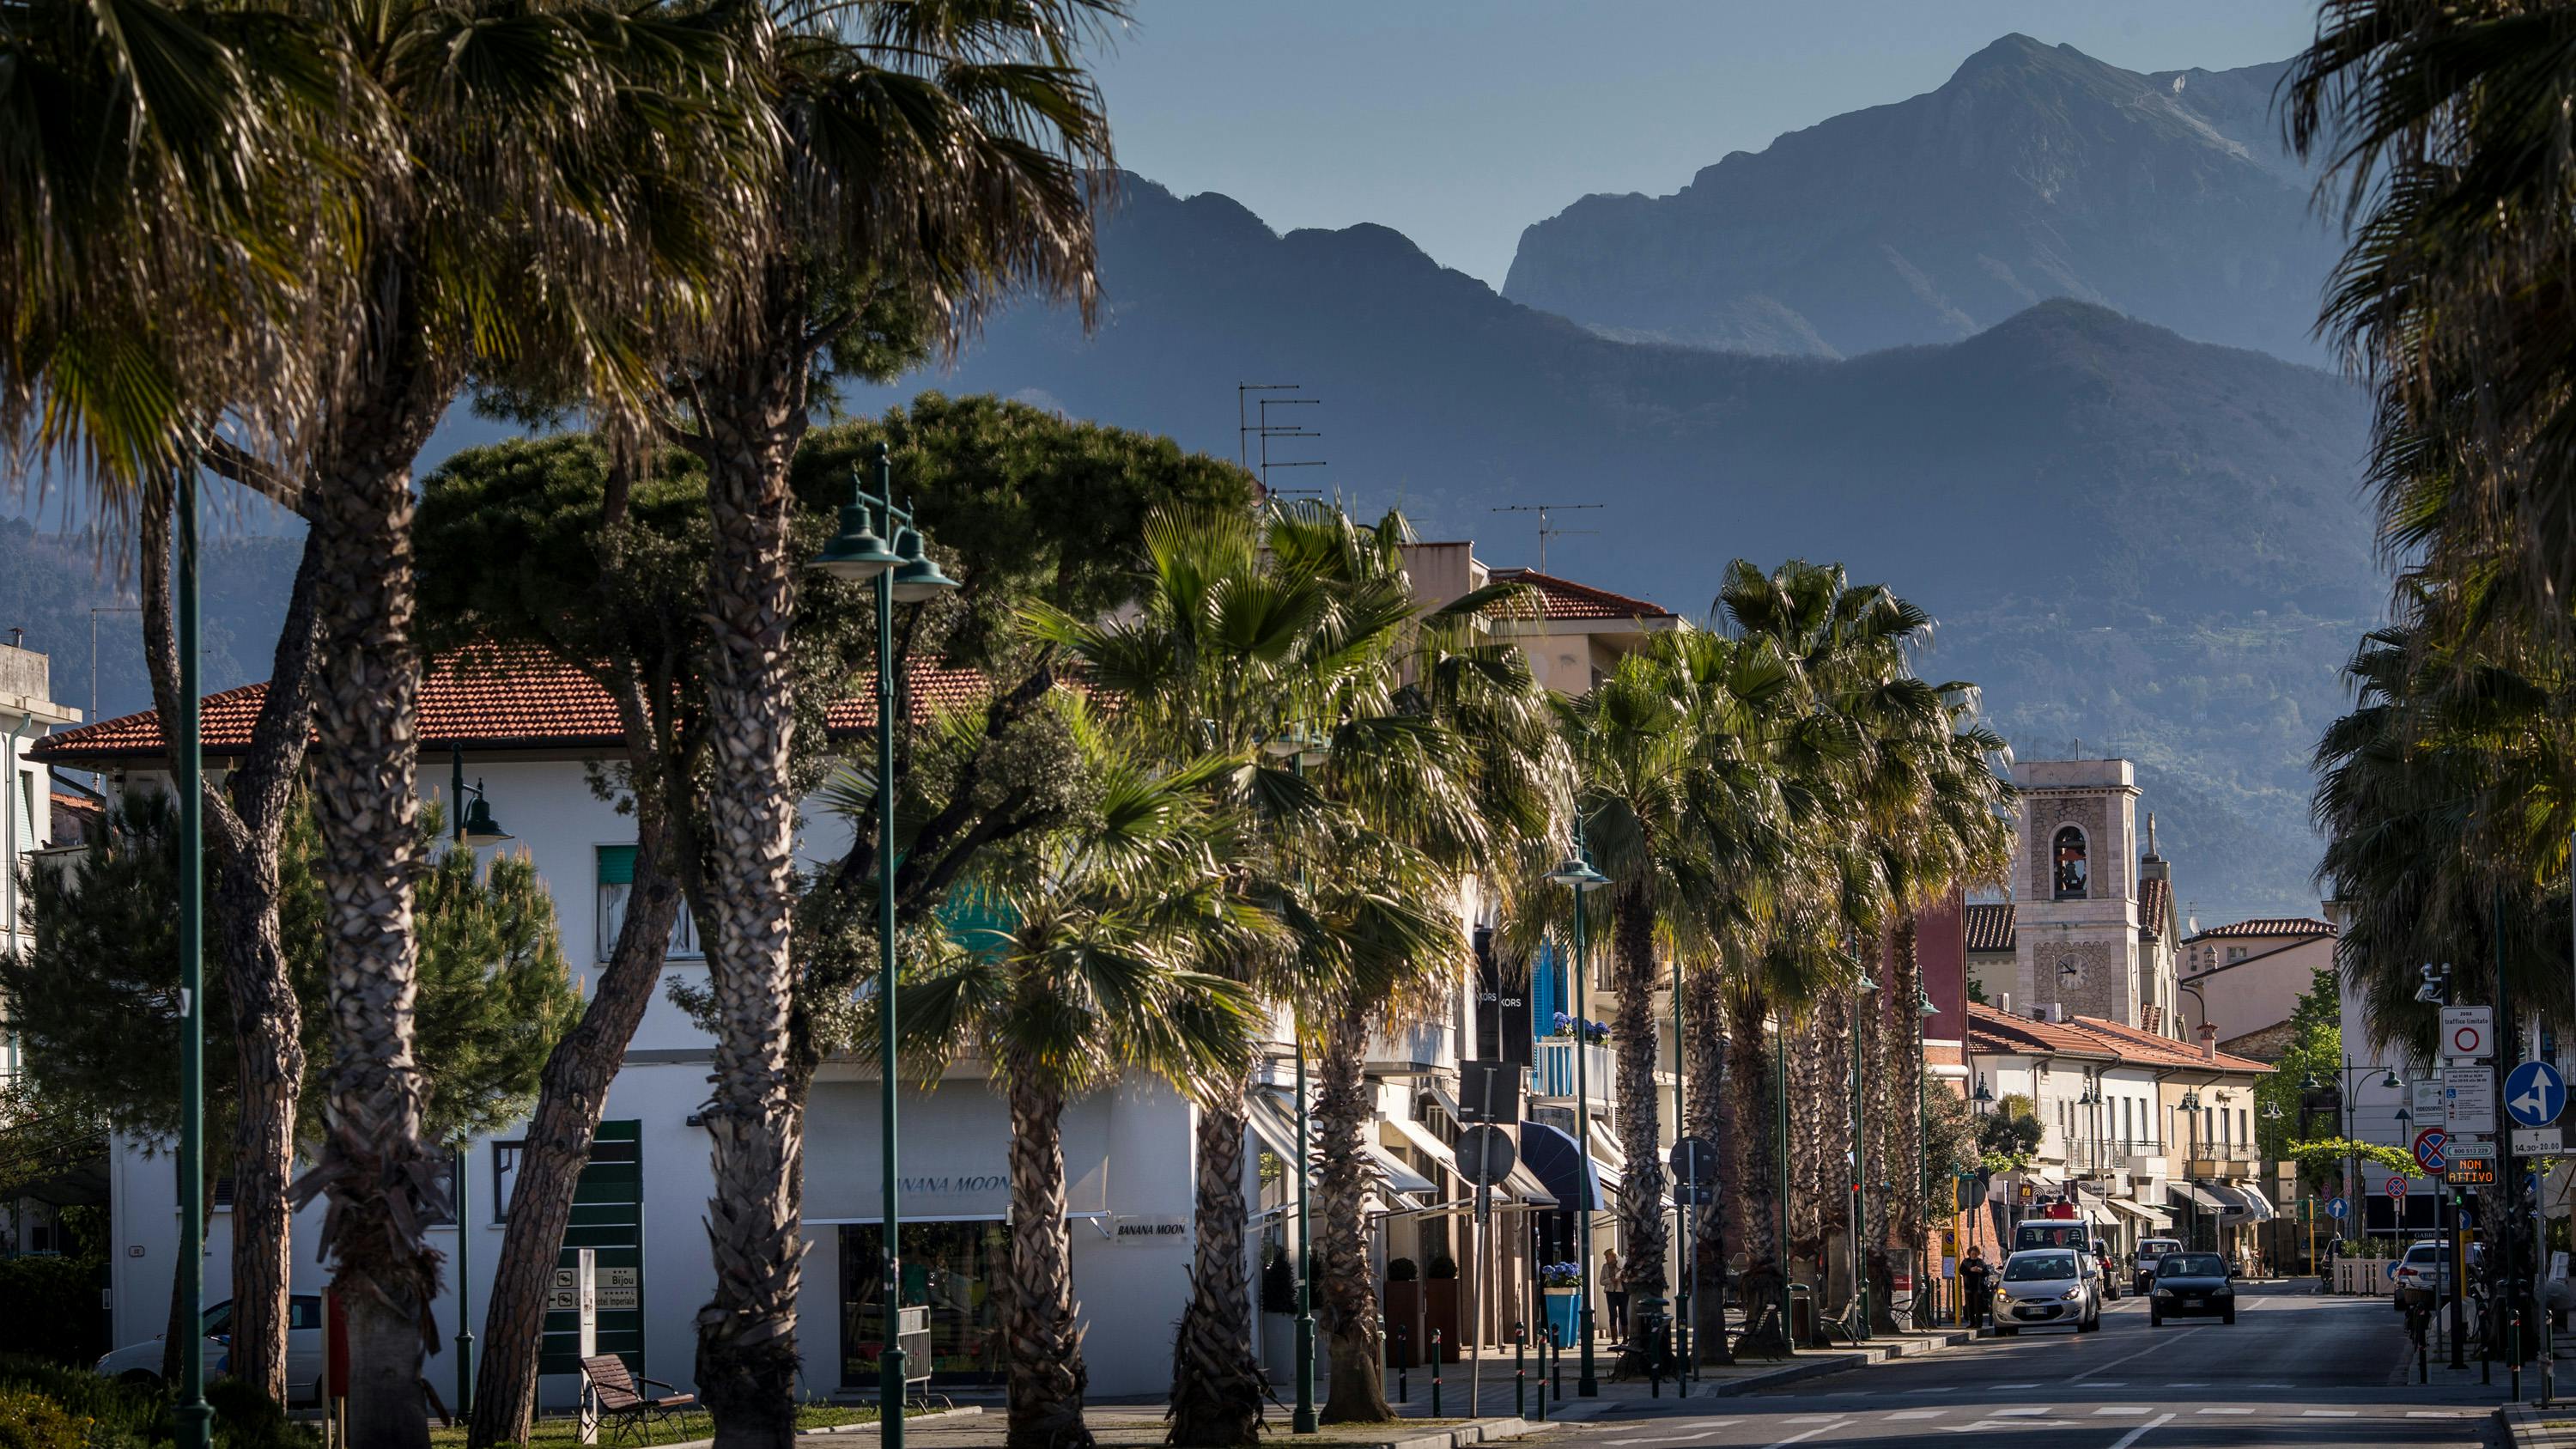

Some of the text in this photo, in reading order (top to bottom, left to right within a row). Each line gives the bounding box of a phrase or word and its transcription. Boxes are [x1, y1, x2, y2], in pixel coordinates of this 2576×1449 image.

[2459, 1160, 2482, 1170] NON
[2449, 1172, 2493, 1183] ATTIVO
[879, 1176, 1011, 1192] NANA MOON
[1118, 1224, 1185, 1236] BANANA MOON
[612, 1275, 634, 1286] Bijou
[595, 1296, 635, 1306] otel Imperiale
